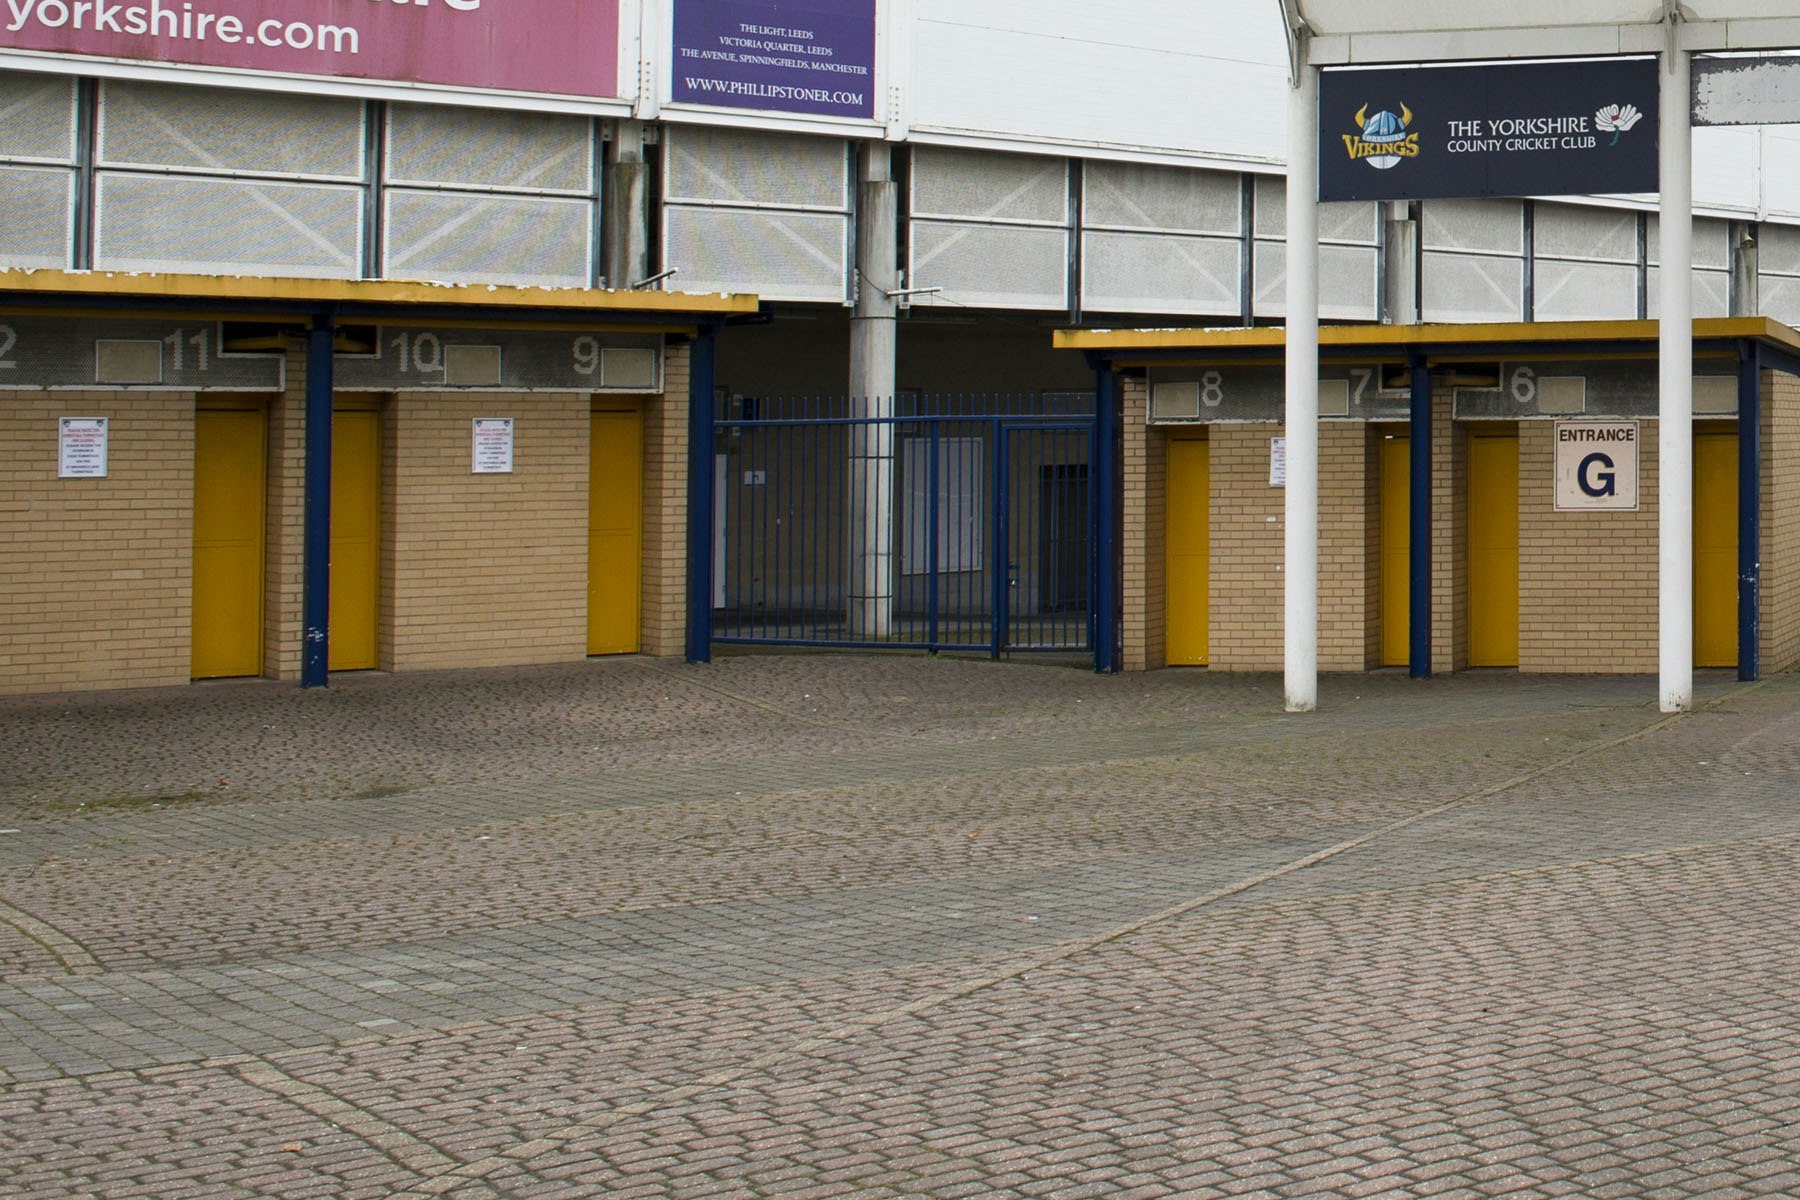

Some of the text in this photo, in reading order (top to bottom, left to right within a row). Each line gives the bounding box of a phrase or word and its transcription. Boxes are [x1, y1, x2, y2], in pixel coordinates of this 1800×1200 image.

[719, 36, 762, 49] VICTORIA
[807, 46, 833, 56] LEEDS
[740, 24, 758, 34] THE
[788, 29, 814, 40] LEEDS
[680, 48, 700, 58] THE
[811, 61, 868, 75] MANCHESTER
[685, 77, 863, 105] WWW.PHILLIPSTONER.COM
[1448, 116, 1589, 137] THE YORKSHIRE
[1341, 131, 1420, 160] VIKINGS
[1447, 135, 1596, 153] COUNTY CRICKET CLUB
[164, 328, 209, 370] 11
[391, 332, 442, 373] 10
[572, 336, 599, 375] 9
[1201, 370, 1223, 407] 8
[1349, 368, 1372, 406] 7
[1510, 366, 1536, 403] 6
[1559, 429, 1634, 441] ENTRANCE
[1577, 452, 1615, 497] G
